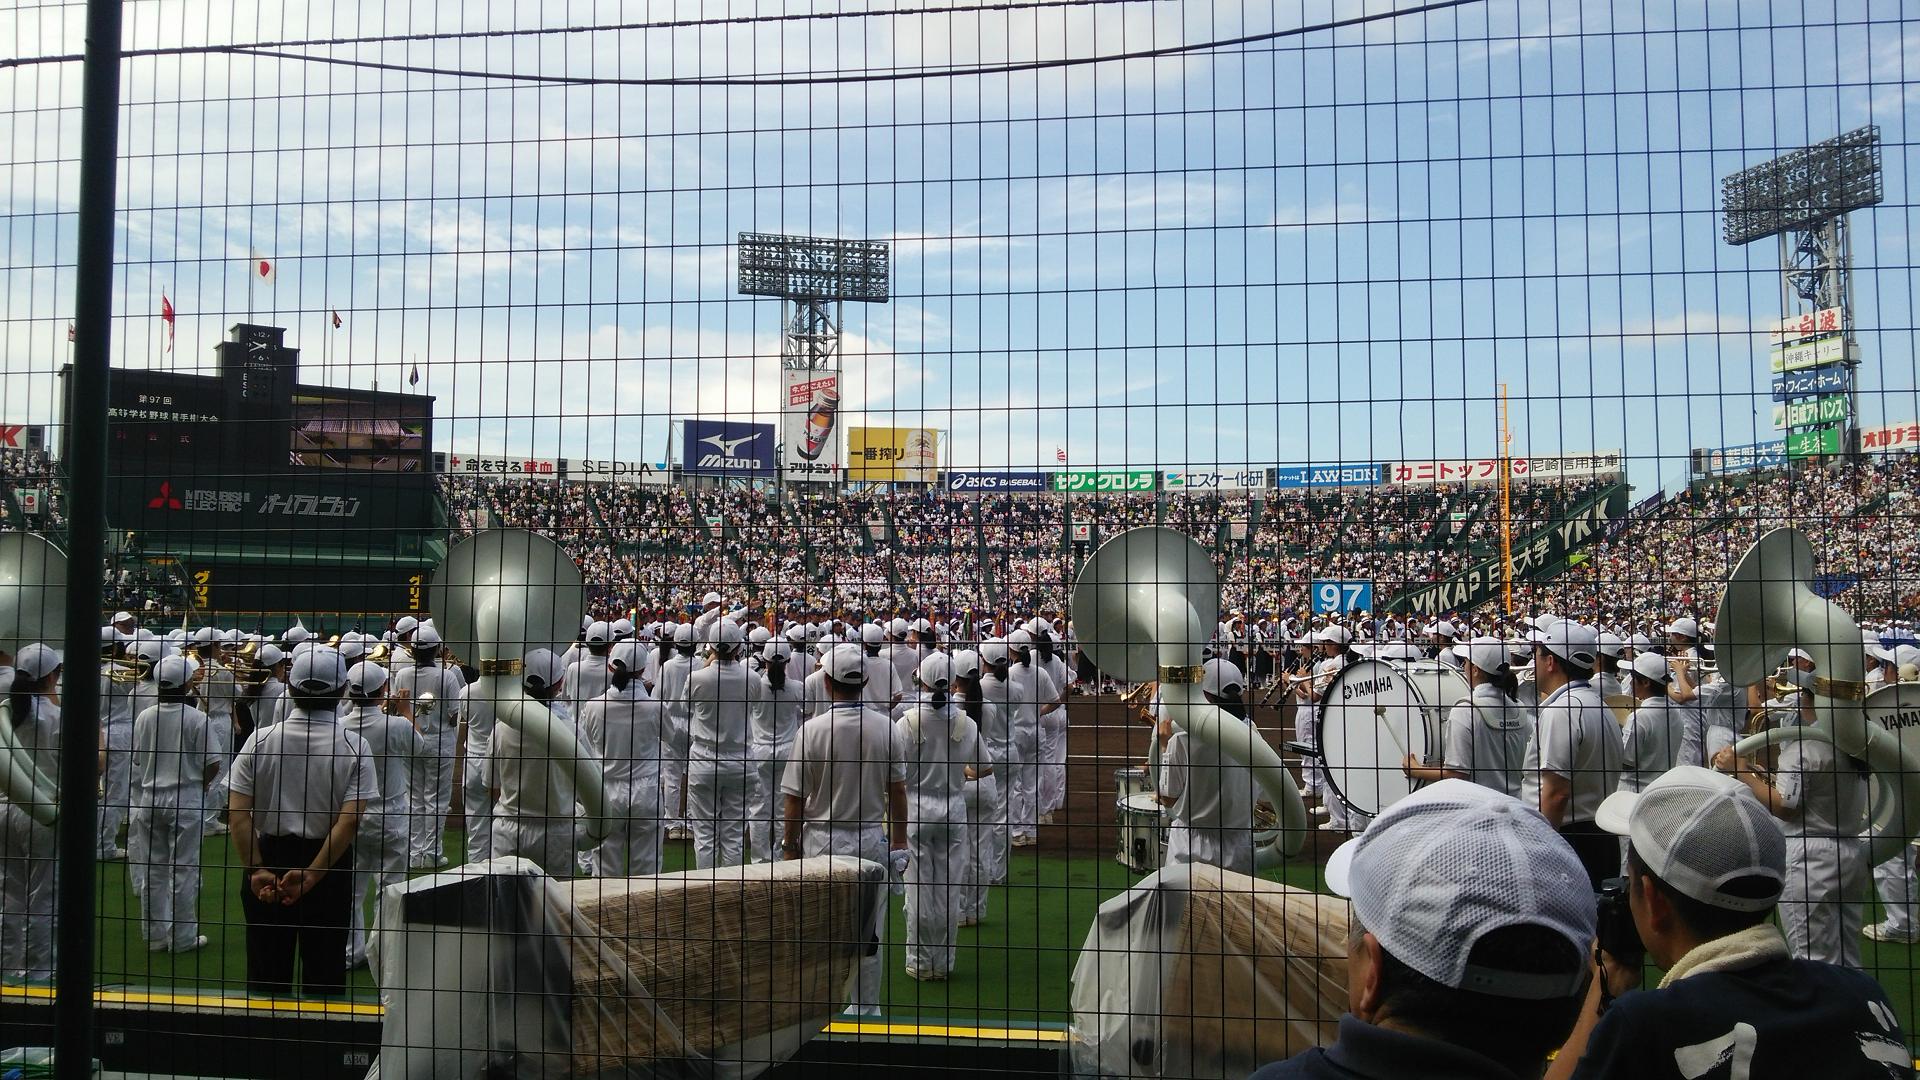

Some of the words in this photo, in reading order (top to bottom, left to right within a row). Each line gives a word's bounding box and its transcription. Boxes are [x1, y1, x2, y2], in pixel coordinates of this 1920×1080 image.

[851, 447, 904, 461] 一番搾り
[465, 458, 553, 475] 命を守る献血
[582, 460, 653, 477] SEDIA
[1395, 459, 1497, 482] カニトップ
[1531, 454, 1618, 472] 尼崎信用金庫
[1000, 478, 1042, 487] BASEBALL
[1056, 474, 1153, 490] サン・クロレラ
[1185, 471, 1264, 487] エスケー化研
[1300, 468, 1378, 484] LAWSON
[185, 490, 250, 503] MITSUBISHI
[184, 501, 242, 513] ELECTRIC
[1557, 497, 1609, 550] YKK
[1488, 535, 1551, 592] 日本大学
[1320, 583, 1364, 612] 97
[1353, 675, 1394, 698] YAMAHA
[1879, 710, 1920, 731] YAMA
[345, 1055, 367, 1065] ABC
